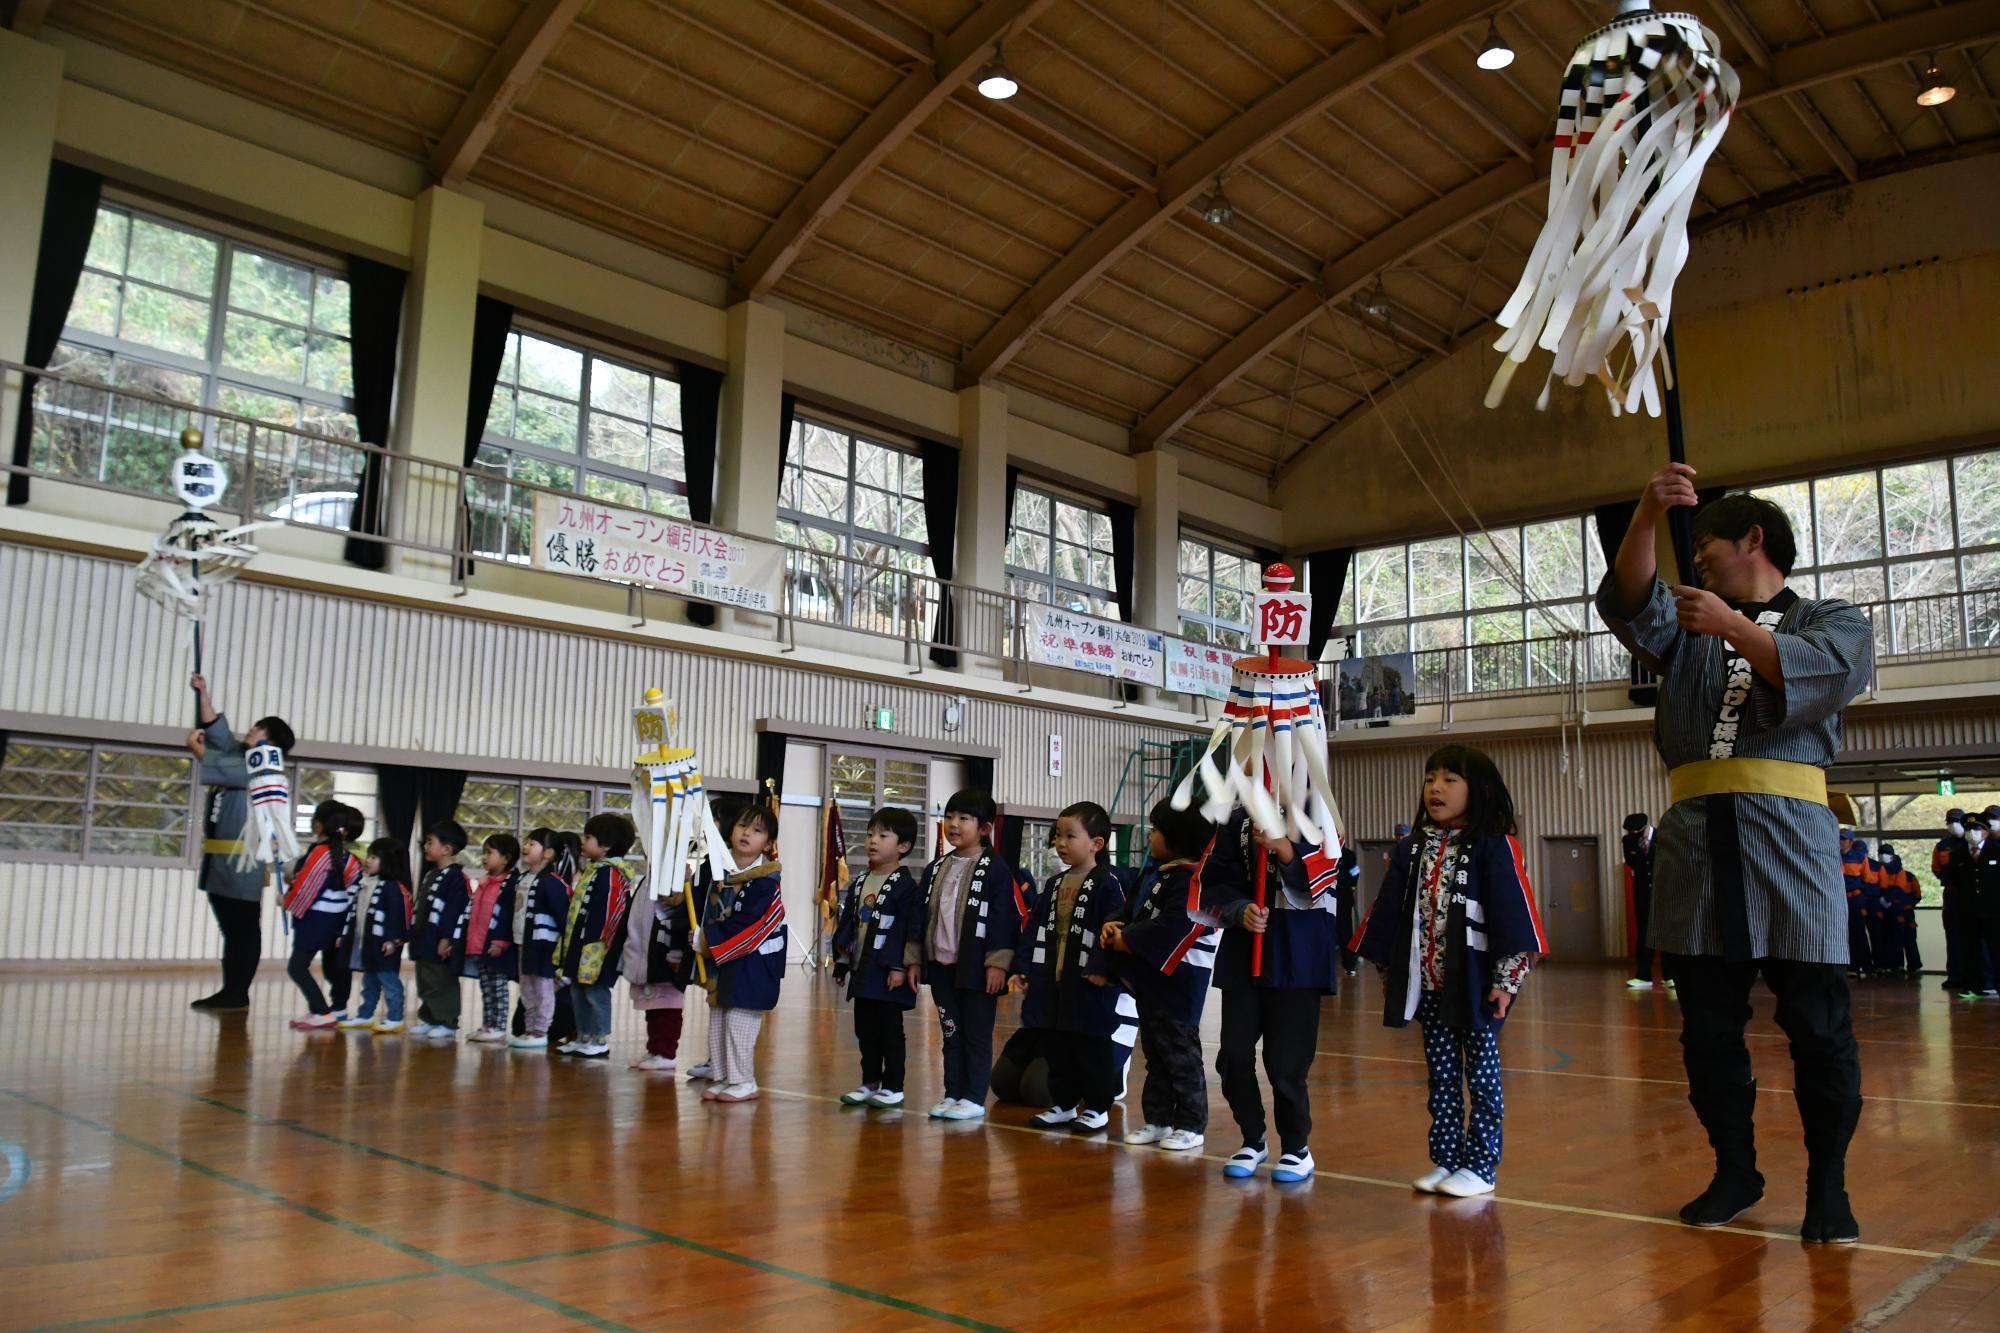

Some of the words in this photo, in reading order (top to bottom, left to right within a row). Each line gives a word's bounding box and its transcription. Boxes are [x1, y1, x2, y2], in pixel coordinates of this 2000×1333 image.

[1259, 598, 1307, 642] 防
[872, 872, 900, 920] 火の用心
[968, 857, 990, 907] 火の用心
[1070, 878, 1094, 934] 火の用心
